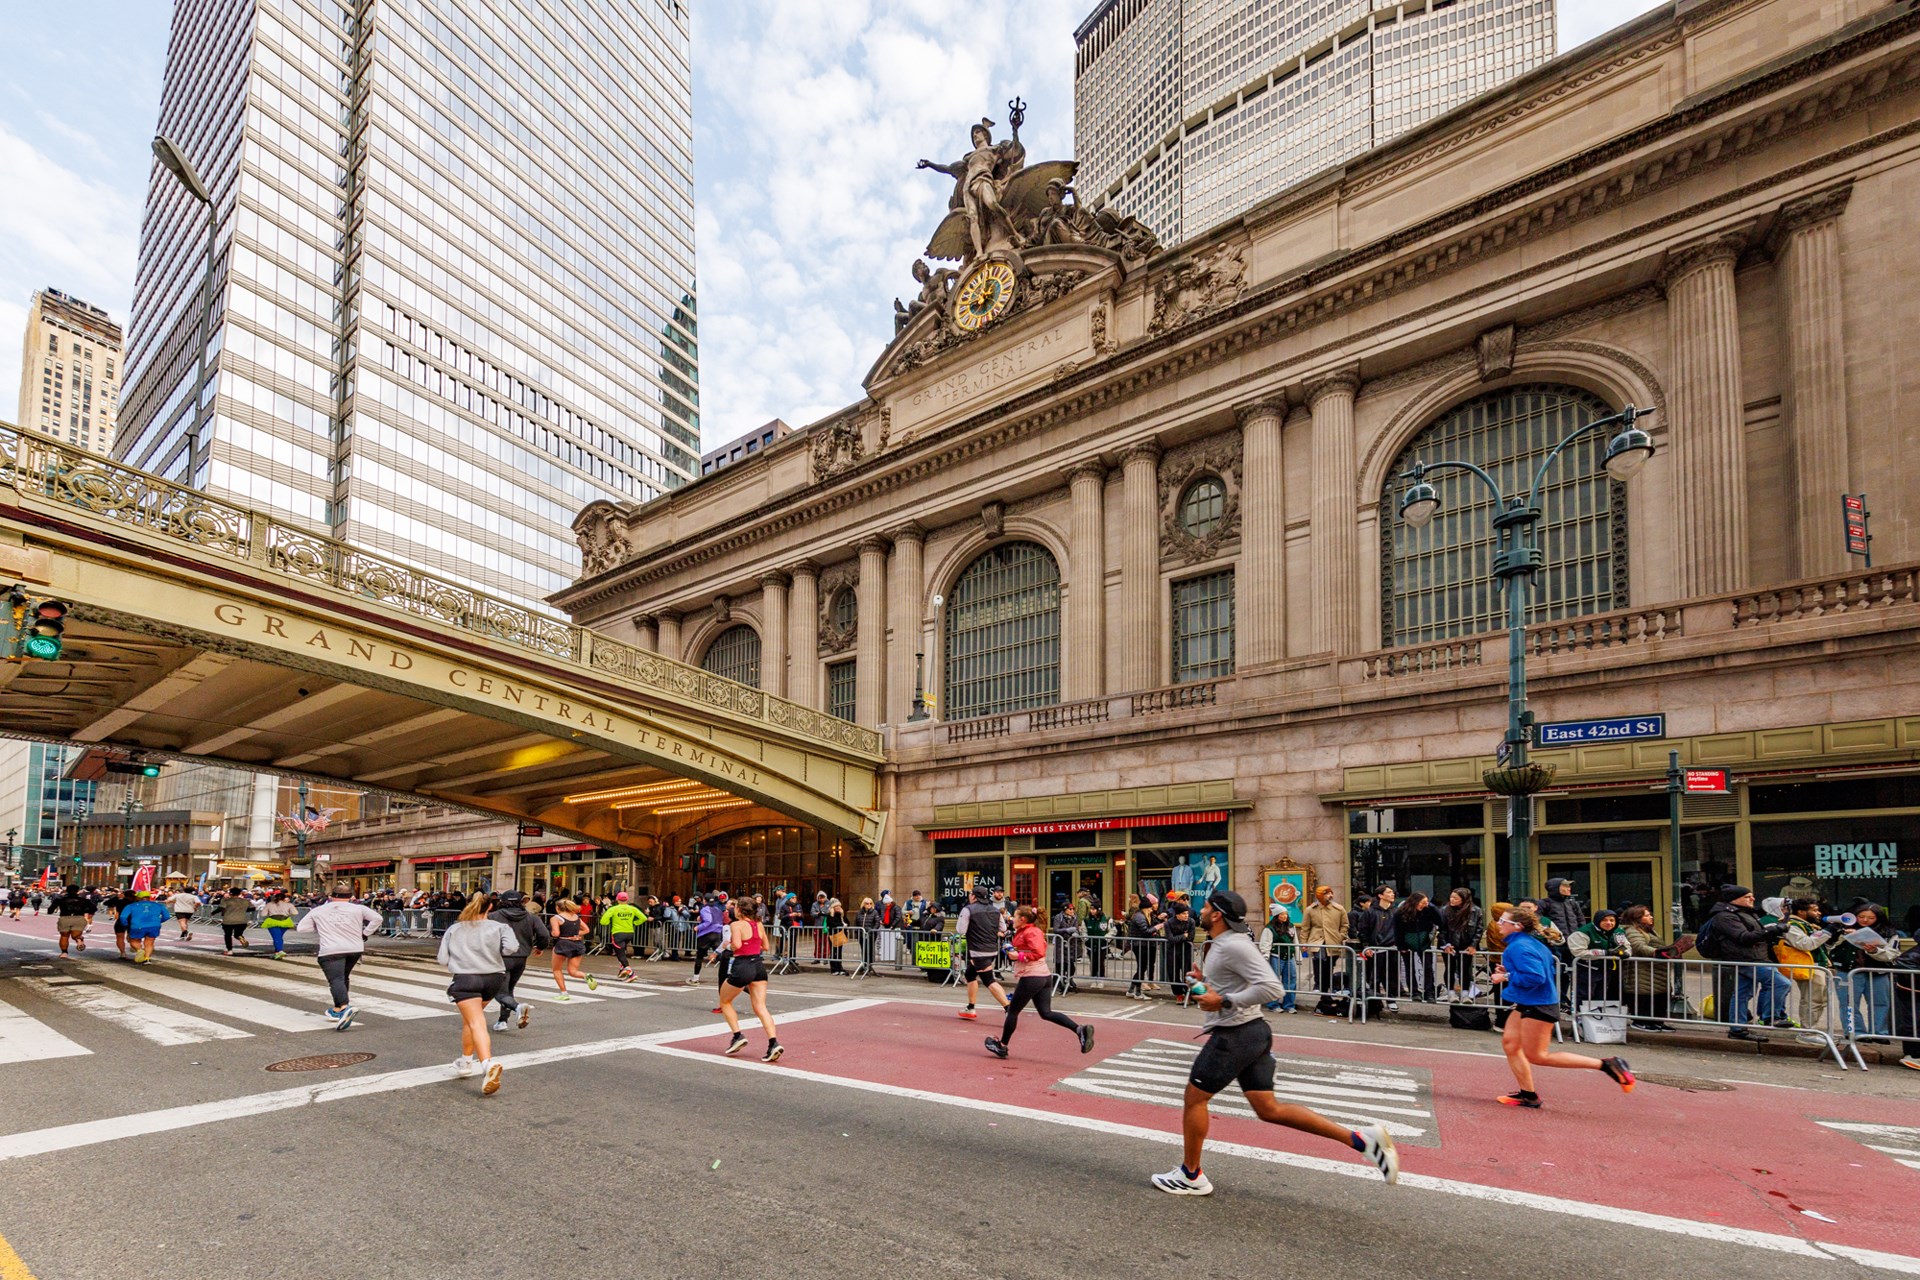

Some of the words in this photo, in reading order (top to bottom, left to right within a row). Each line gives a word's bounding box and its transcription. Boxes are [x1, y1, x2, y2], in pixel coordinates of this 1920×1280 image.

[912, 372, 968, 407] GRAND
[979, 329, 1063, 375] CENTRAL
[942, 360, 1027, 406] TERMINAL
[214, 604, 413, 671] GRAND
[448, 669, 616, 733] CENTRAL
[637, 729, 760, 786] TERMINAL
[1546, 727, 1584, 741] East
[1587, 724, 1631, 738] 42nd
[1636, 721, 1656, 734] St
[1013, 825, 1055, 835] CHARLES
[1057, 821, 1112, 832] TYRWHITT
[1814, 842, 1897, 859] BRKLN
[1815, 859, 1898, 876] BLOKE
[943, 877, 960, 886] WE
[964, 876, 996, 886] EAN
[944, 888, 995, 897] BUSIS
[937, 944, 949, 953] This
[917, 953, 948, 965] Achilles
